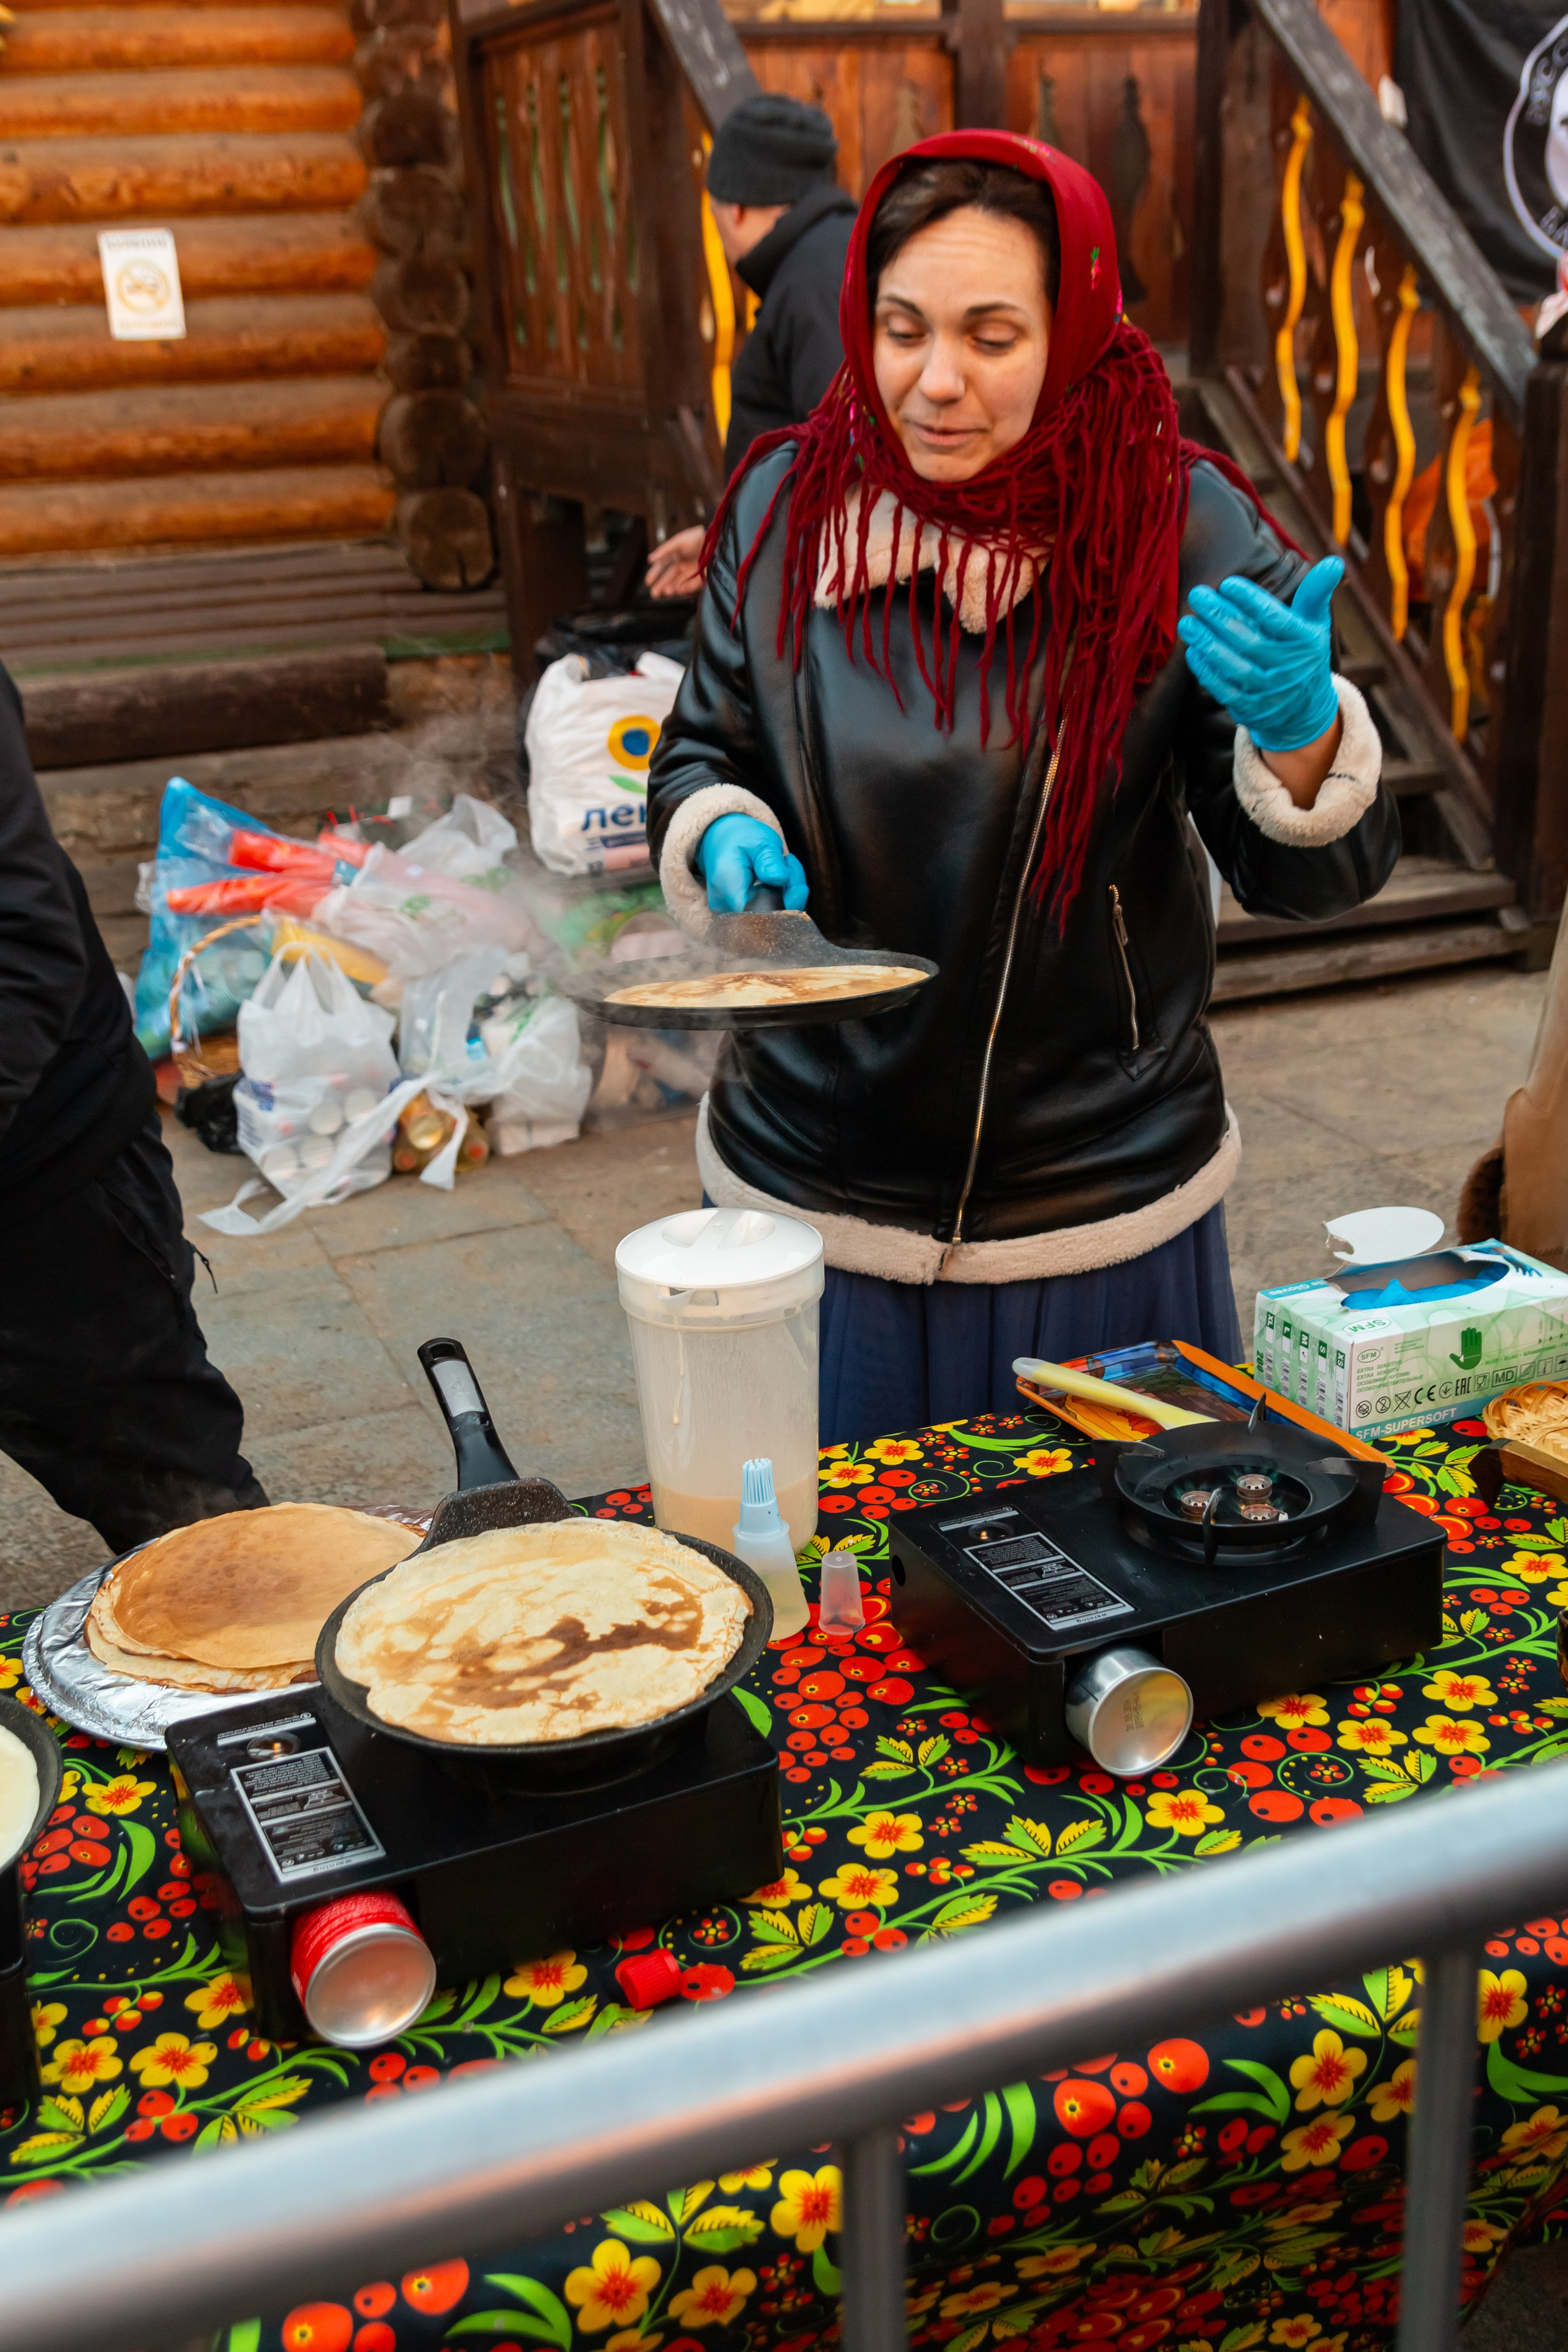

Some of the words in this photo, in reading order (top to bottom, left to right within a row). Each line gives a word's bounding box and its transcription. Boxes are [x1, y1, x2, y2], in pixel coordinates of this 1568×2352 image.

[1267, 1313, 1274, 1326] XL
[1348, 1319, 1387, 1332] SFM
[1301, 1333, 1308, 1346] M
[1319, 1345, 1326, 1354] S
[1361, 1351, 1377, 1360] SFM
[1337, 1352, 1344, 1367] XS
[1377, 1359, 1403, 1370] SENSITIVE
[1377, 1366, 1400, 1376] SENSITIV
[1495, 1370, 1514, 1384] MD
[1357, 1375, 1387, 1387] ОСОБЛИВО
[1355, 1408, 1457, 1441] SFM-SUPERSOFT
[1076, 1613, 1108, 1623] warning
[312, 1858, 353, 1872] warning
